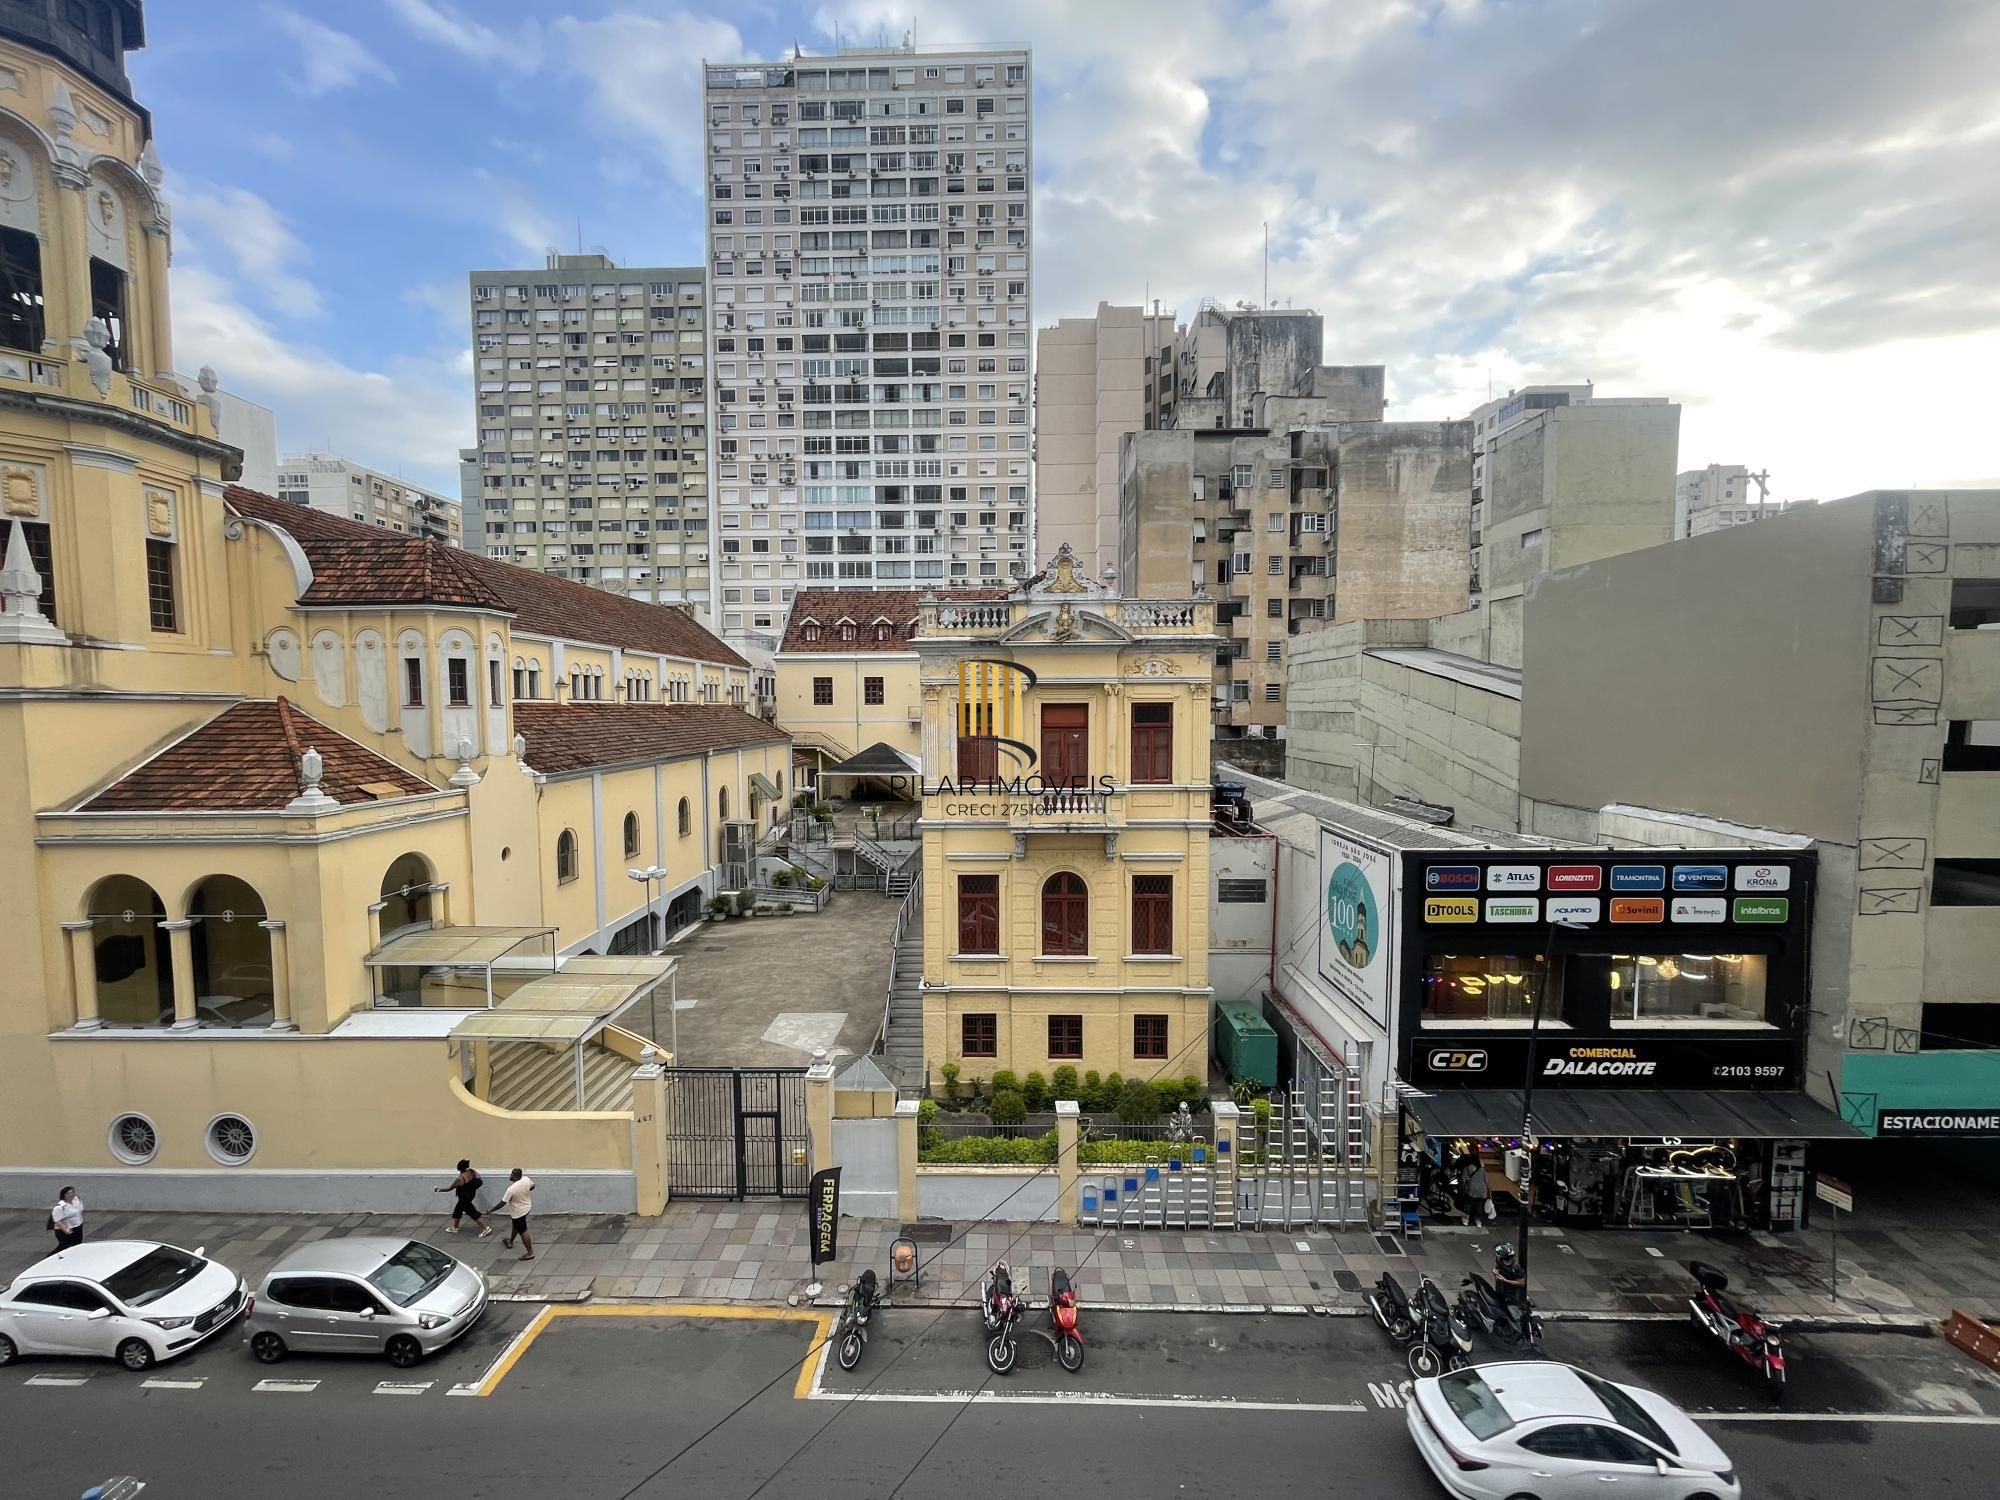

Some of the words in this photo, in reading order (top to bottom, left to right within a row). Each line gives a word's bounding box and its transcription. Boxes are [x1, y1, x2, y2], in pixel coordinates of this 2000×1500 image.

[1440, 873, 1478, 883] BOSCH
[1506, 872, 1535, 881] ATLAS
[1555, 874, 1594, 882] LORENZETTI
[1746, 878, 1778, 886] KRONA
[1331, 896, 1355, 930] 100
[1489, 905, 1534, 916] TASCHIBRA
[1627, 906, 1659, 915] Suvinil
[1740, 906, 1781, 915] intelbras
[1569, 1048, 1637, 1058] COMERCIAL
[1432, 1053, 1484, 1068] CDC
[1543, 1059, 1657, 1076] DALACORTE
[1721, 1066, 1751, 1076] 2103
[1754, 1066, 1785, 1076] 9597
[1883, 1116, 2000, 1129] ESTACIONAME
[821, 1179, 835, 1253] FERRAGEM
